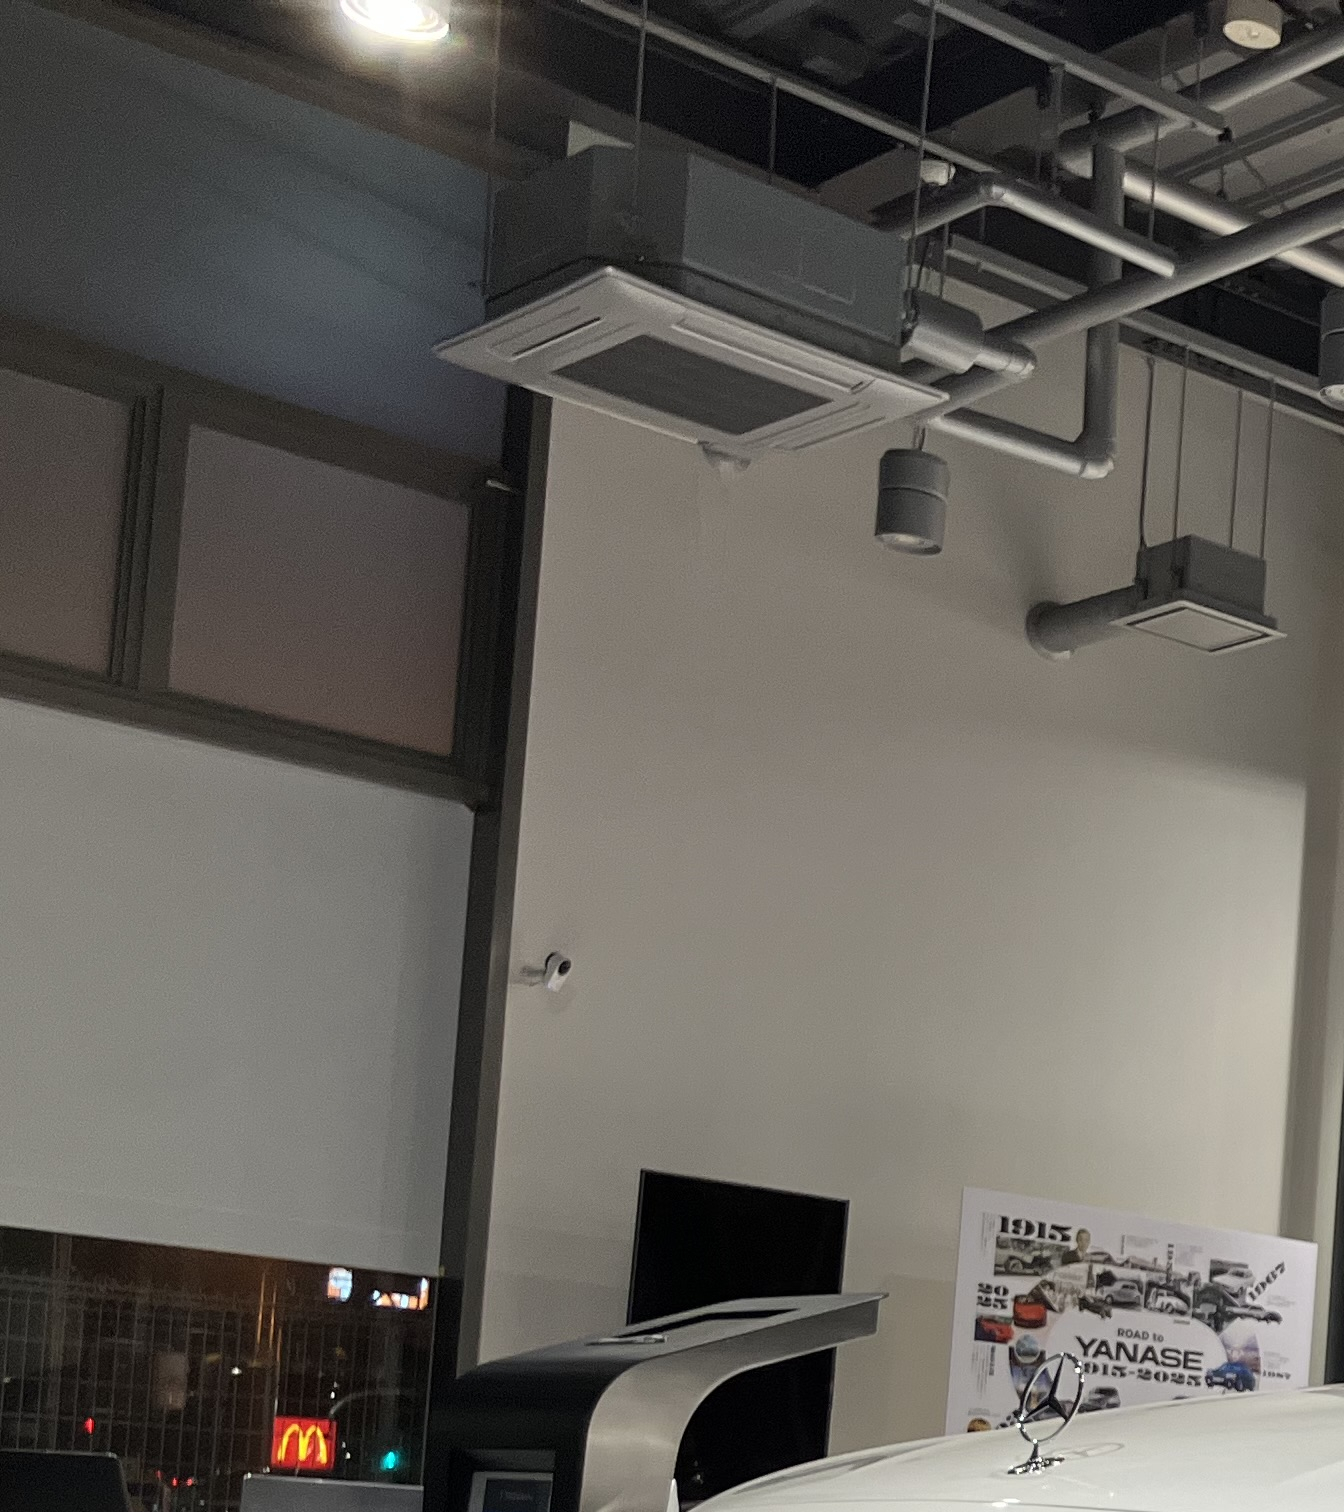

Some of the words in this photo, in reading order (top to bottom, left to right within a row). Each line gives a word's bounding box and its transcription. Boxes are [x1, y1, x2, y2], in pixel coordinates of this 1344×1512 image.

[999, 1215, 1073, 1243] 1915
[1117, 1328, 1150, 1341] ROAD
[1153, 1332, 1164, 1342] to
[1075, 1335, 1204, 1371] YANASE
[1084, 1361, 1202, 1387] 915-2025
